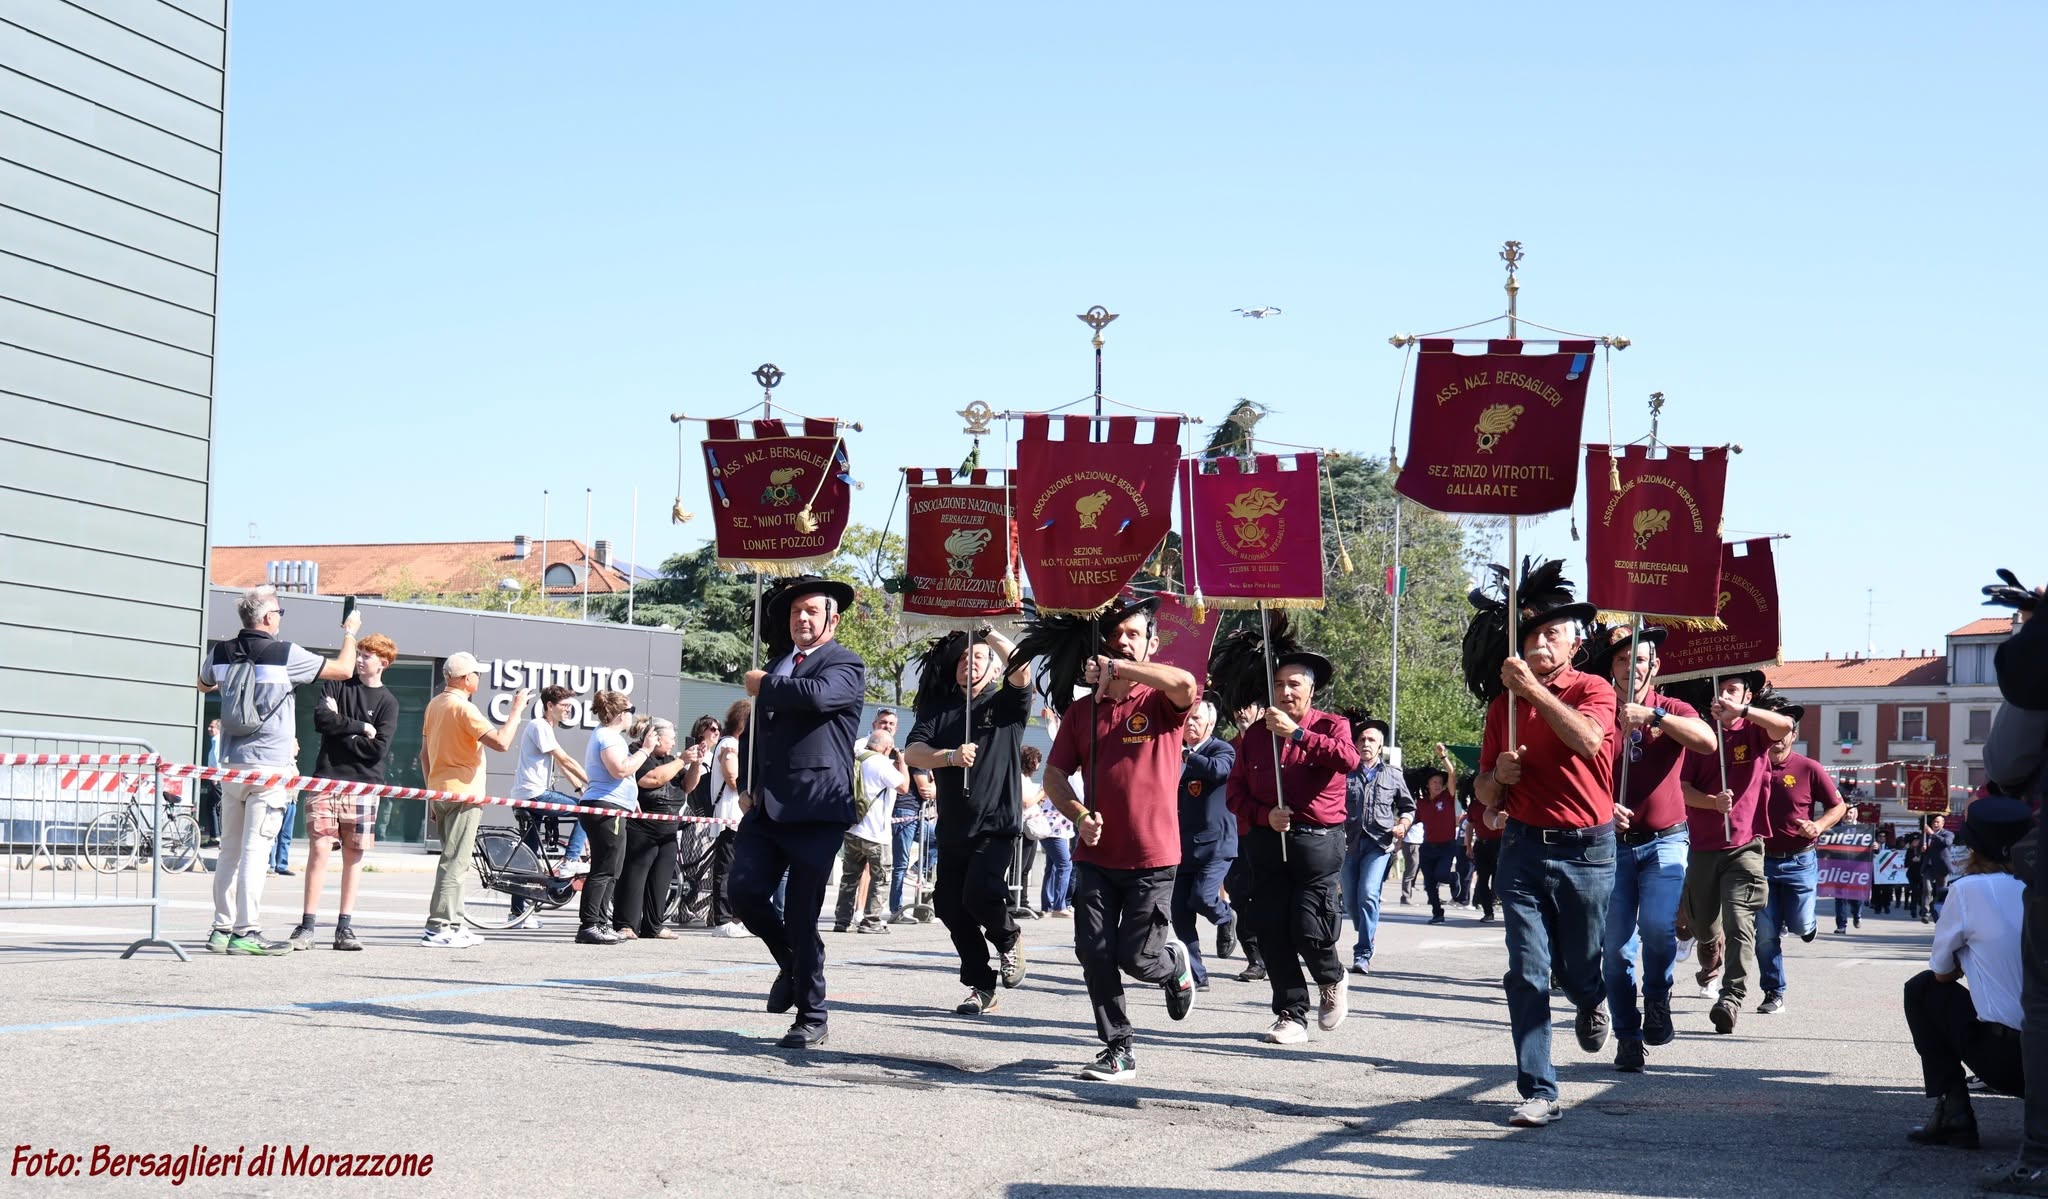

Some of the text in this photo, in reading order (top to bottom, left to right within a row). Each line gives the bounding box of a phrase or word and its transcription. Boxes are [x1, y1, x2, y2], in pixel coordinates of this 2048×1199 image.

[1436, 371, 1563, 407] ASS. NAZ. BERSAGLIERI
[722, 446, 830, 479] ASS. NAZ. BERSAGLIER
[1427, 464, 1450, 477] SEZ.
[1032, 471, 1150, 520] ASSOCIAZIONE NAZIONALE BERSAGLIERI
[1446, 483, 1518, 497] GALLARATE
[912, 497, 967, 515] ASSOCIAZIONE
[1603, 479, 1636, 527] ASSOCIAZIONE
[1676, 485, 1703, 533] BERSAGLIERI
[733, 517, 752, 529] SEZ.
[940, 514, 985, 525] BERSAGLIERI
[742, 536, 825, 550] LONATE POZZOLO
[1073, 547, 1103, 556] SEZIONE
[1065, 558, 1090, 567] CARETTI
[1639, 561, 1689, 574] MEREGAGLIA
[1069, 569, 1118, 585] VARESE
[1627, 571, 1668, 586] TRADATE
[944, 578, 997, 593] MORAZZONE
[1731, 574, 1768, 613] BERSAGLIERI
[956, 598, 990, 608] GIUSEPPE
[1160, 611, 1200, 639] BERSAGLIERI
[1688, 635, 1737, 648] SEZIONE
[1678, 651, 1750, 666] VERGIATE
[493, 658, 635, 696] ISTITUTO
[1817, 867, 1870, 885] gliere
